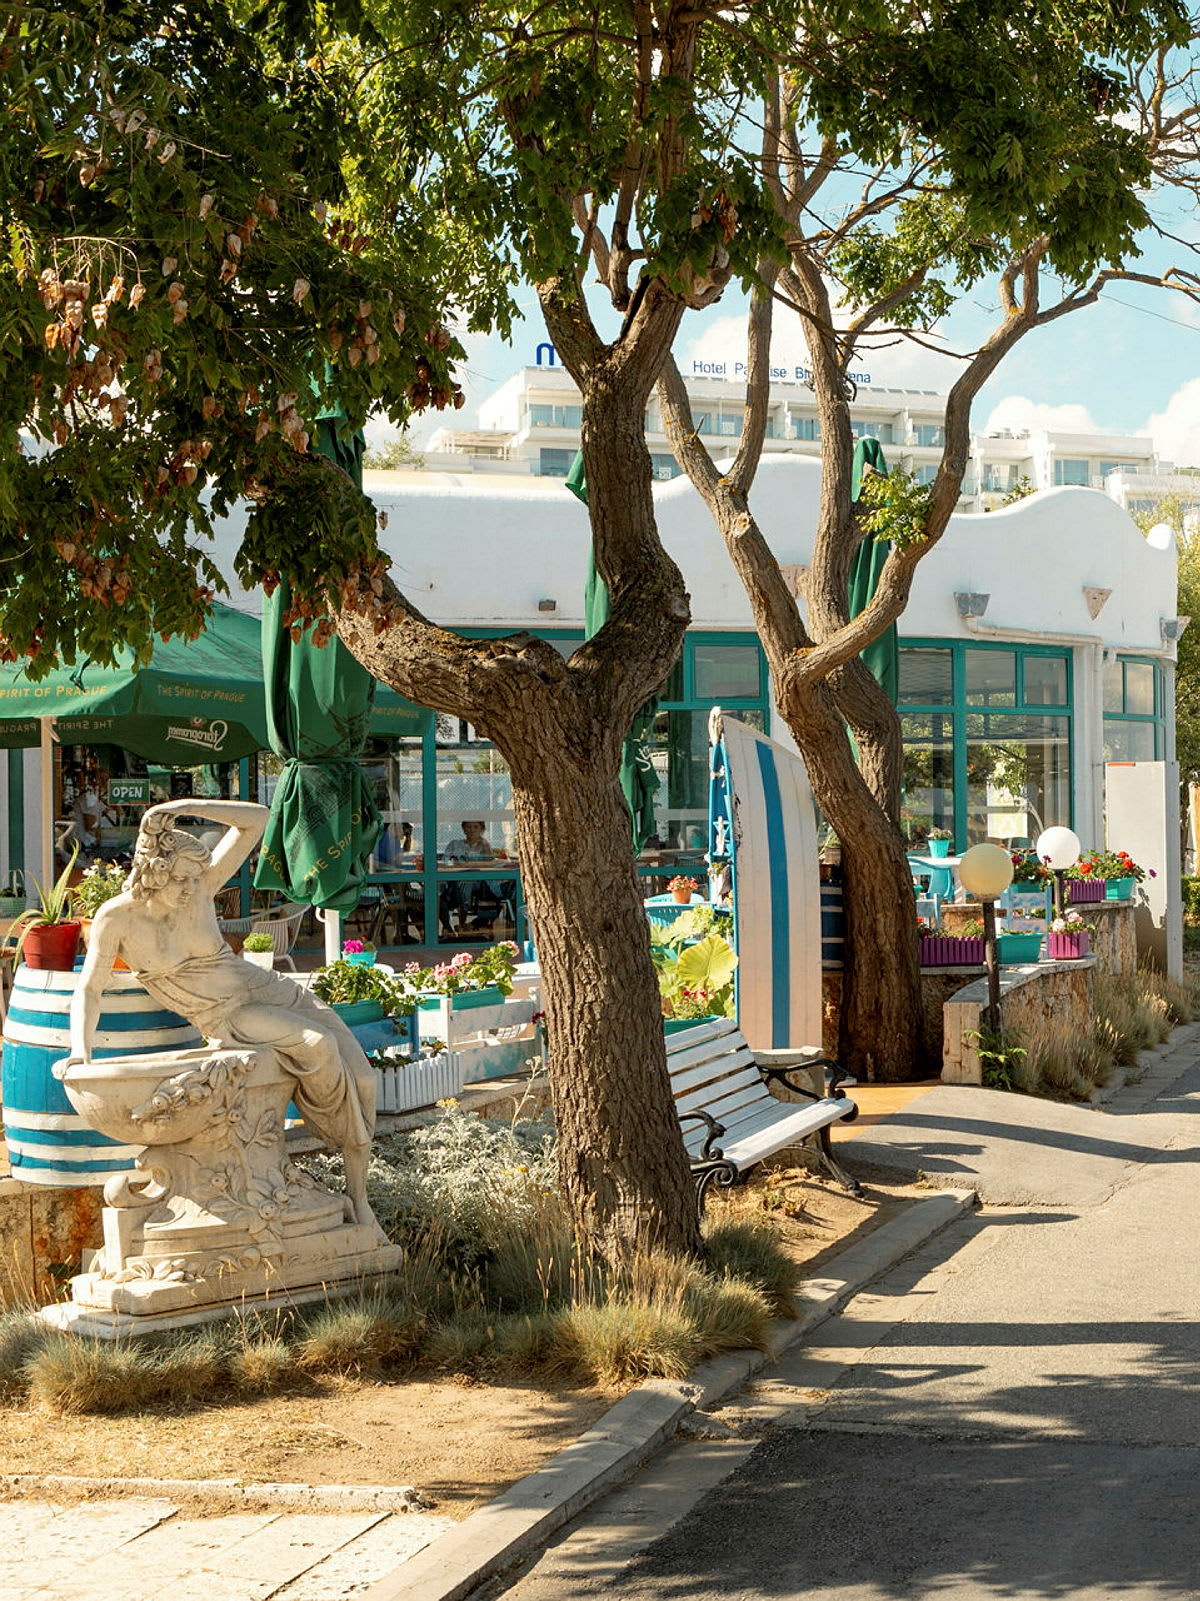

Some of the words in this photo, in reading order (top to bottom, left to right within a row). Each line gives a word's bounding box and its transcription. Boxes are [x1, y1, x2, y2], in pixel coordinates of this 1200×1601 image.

[693, 360, 726, 374] Hotel
[735, 362, 787, 378] Paise
[0, 688, 32, 698] PIRIT
[34, 688, 52, 698] OF
[112, 786, 143, 798] OPEN
